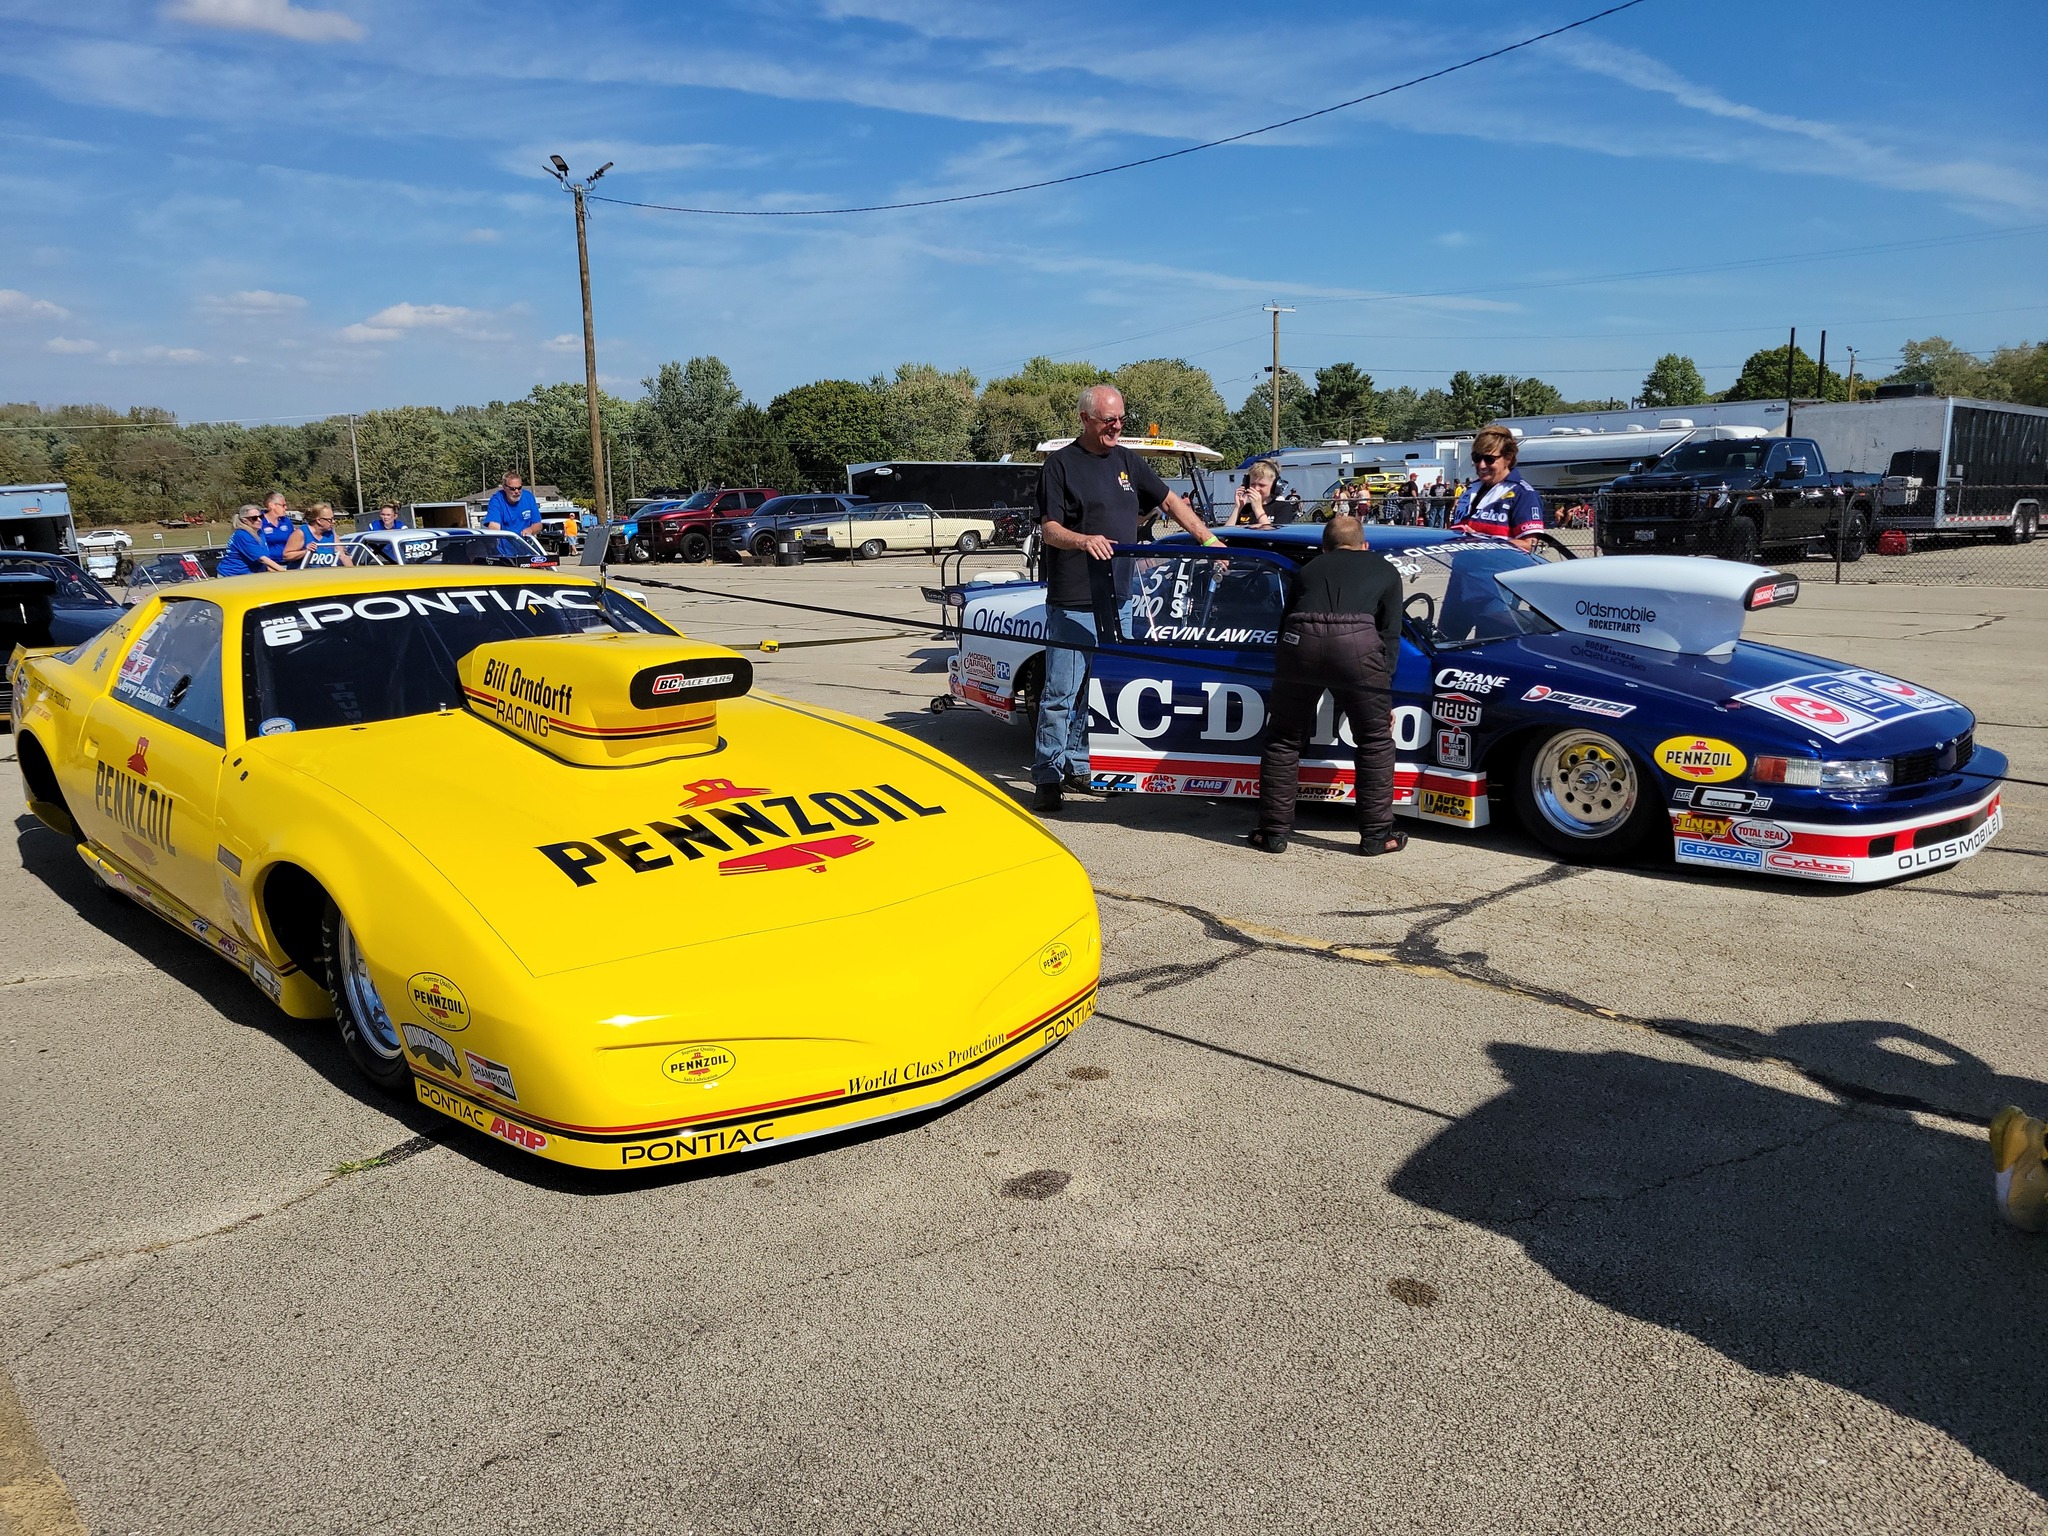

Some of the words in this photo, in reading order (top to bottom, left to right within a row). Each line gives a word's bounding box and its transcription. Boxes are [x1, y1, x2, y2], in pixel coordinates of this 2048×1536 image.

[405, 540, 438, 552] PRO1
[310, 551, 341, 567] PRO1
[1144, 565, 1170, 595] 5
[299, 590, 606, 630] PONTIAC
[1131, 594, 1164, 618] PRO
[1575, 600, 1656, 623] Oldsmobile
[260, 616, 297, 628] PRO
[1588, 619, 1641, 633] ROCKETPARTS
[263, 624, 304, 647] 6
[1144, 626, 1205, 642] KEVIN
[1206, 628, 1279, 644] LAWRE
[997, 663, 1010, 677] PPG
[1435, 668, 1510, 688] CRANE
[483, 658, 509, 690] Bill
[509, 667, 573, 716] Orndorff
[659, 679, 678, 690] BC
[678, 679, 704, 688] RACE
[706, 675, 732, 684] CARS
[496, 698, 550, 738] RACING
[1443, 742, 1464, 750] HURST
[1665, 750, 1733, 767] PENNZOIL
[1190, 780, 1222, 789] LAMB
[1233, 780, 1260, 796] MS
[95, 758, 177, 857] PENNZOIL
[1436, 795, 1465, 807] Auto
[1710, 800, 1736, 808] GASKET
[1676, 813, 1732, 834] INDY
[1738, 826, 1762, 838] TOTAL
[1764, 829, 1785, 841] SEAL
[533, 783, 948, 888] PENNZOIL
[1898, 817, 1997, 870] OLDSMOBILE
[1684, 844, 1757, 862] CRAGAR
[1767, 866, 1802, 874] PERFORMANCE
[1768, 853, 1852, 875] Cyclone
[1043, 948, 1069, 970] PENNZOIL
[413, 988, 465, 1015] PENNZOIL
[670, 1054, 729, 1074] PENNZOIL
[848, 1068, 899, 1096] World
[902, 1058, 945, 1084] Class
[947, 1032, 1006, 1069] Protection
[470, 1063, 511, 1089] CHAMPION
[420, 1083, 485, 1128] PONTIAC
[490, 1116, 547, 1151] ARP
[621, 1122, 775, 1165] PONTIAC
